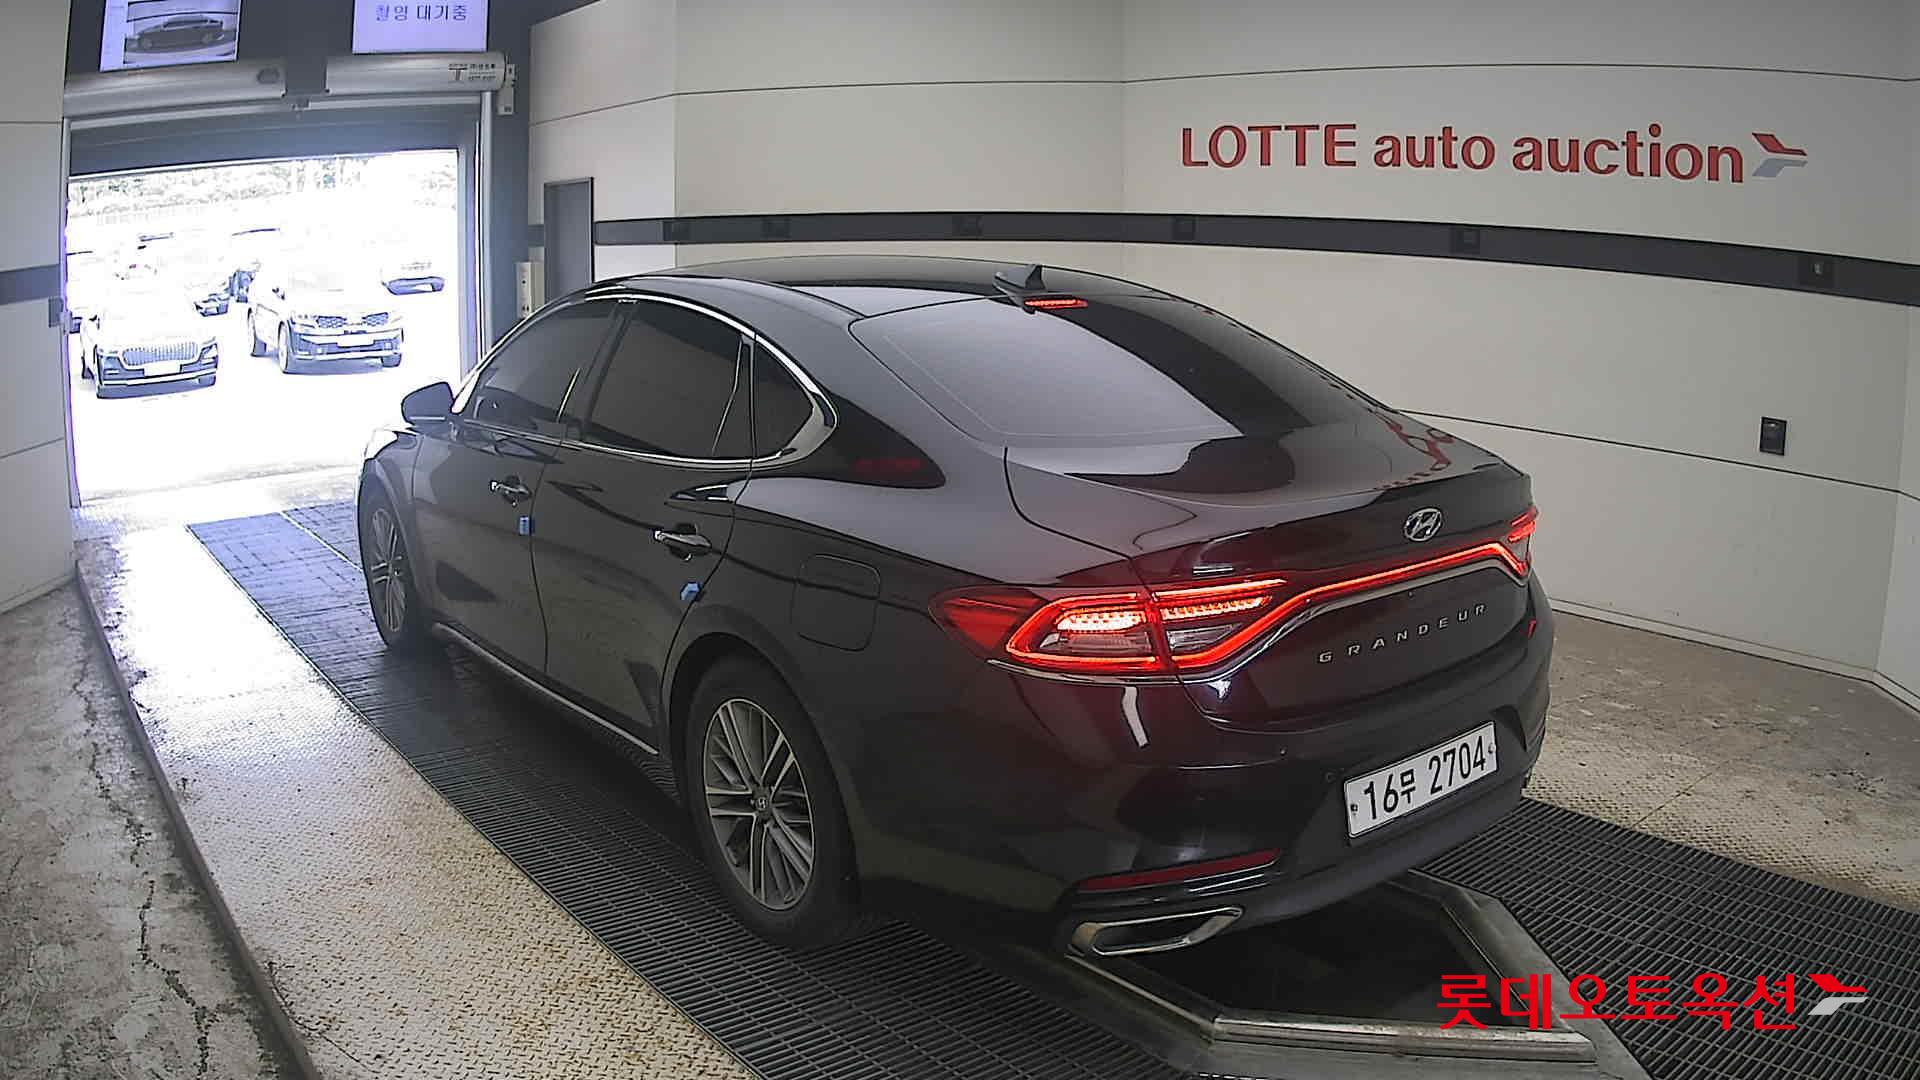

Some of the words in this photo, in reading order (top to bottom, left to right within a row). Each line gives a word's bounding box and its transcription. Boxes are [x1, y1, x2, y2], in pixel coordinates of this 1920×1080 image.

[417, 4, 466, 21] 대기중
[1182, 124, 1357, 168] LOTTE
[1373, 127, 1495, 169] auto
[1512, 124, 1743, 183] auction
[1318, 604, 1487, 663] GRANDEUR
[1363, 768, 1416, 820] 16무
[1428, 735, 1486, 795] 2704
